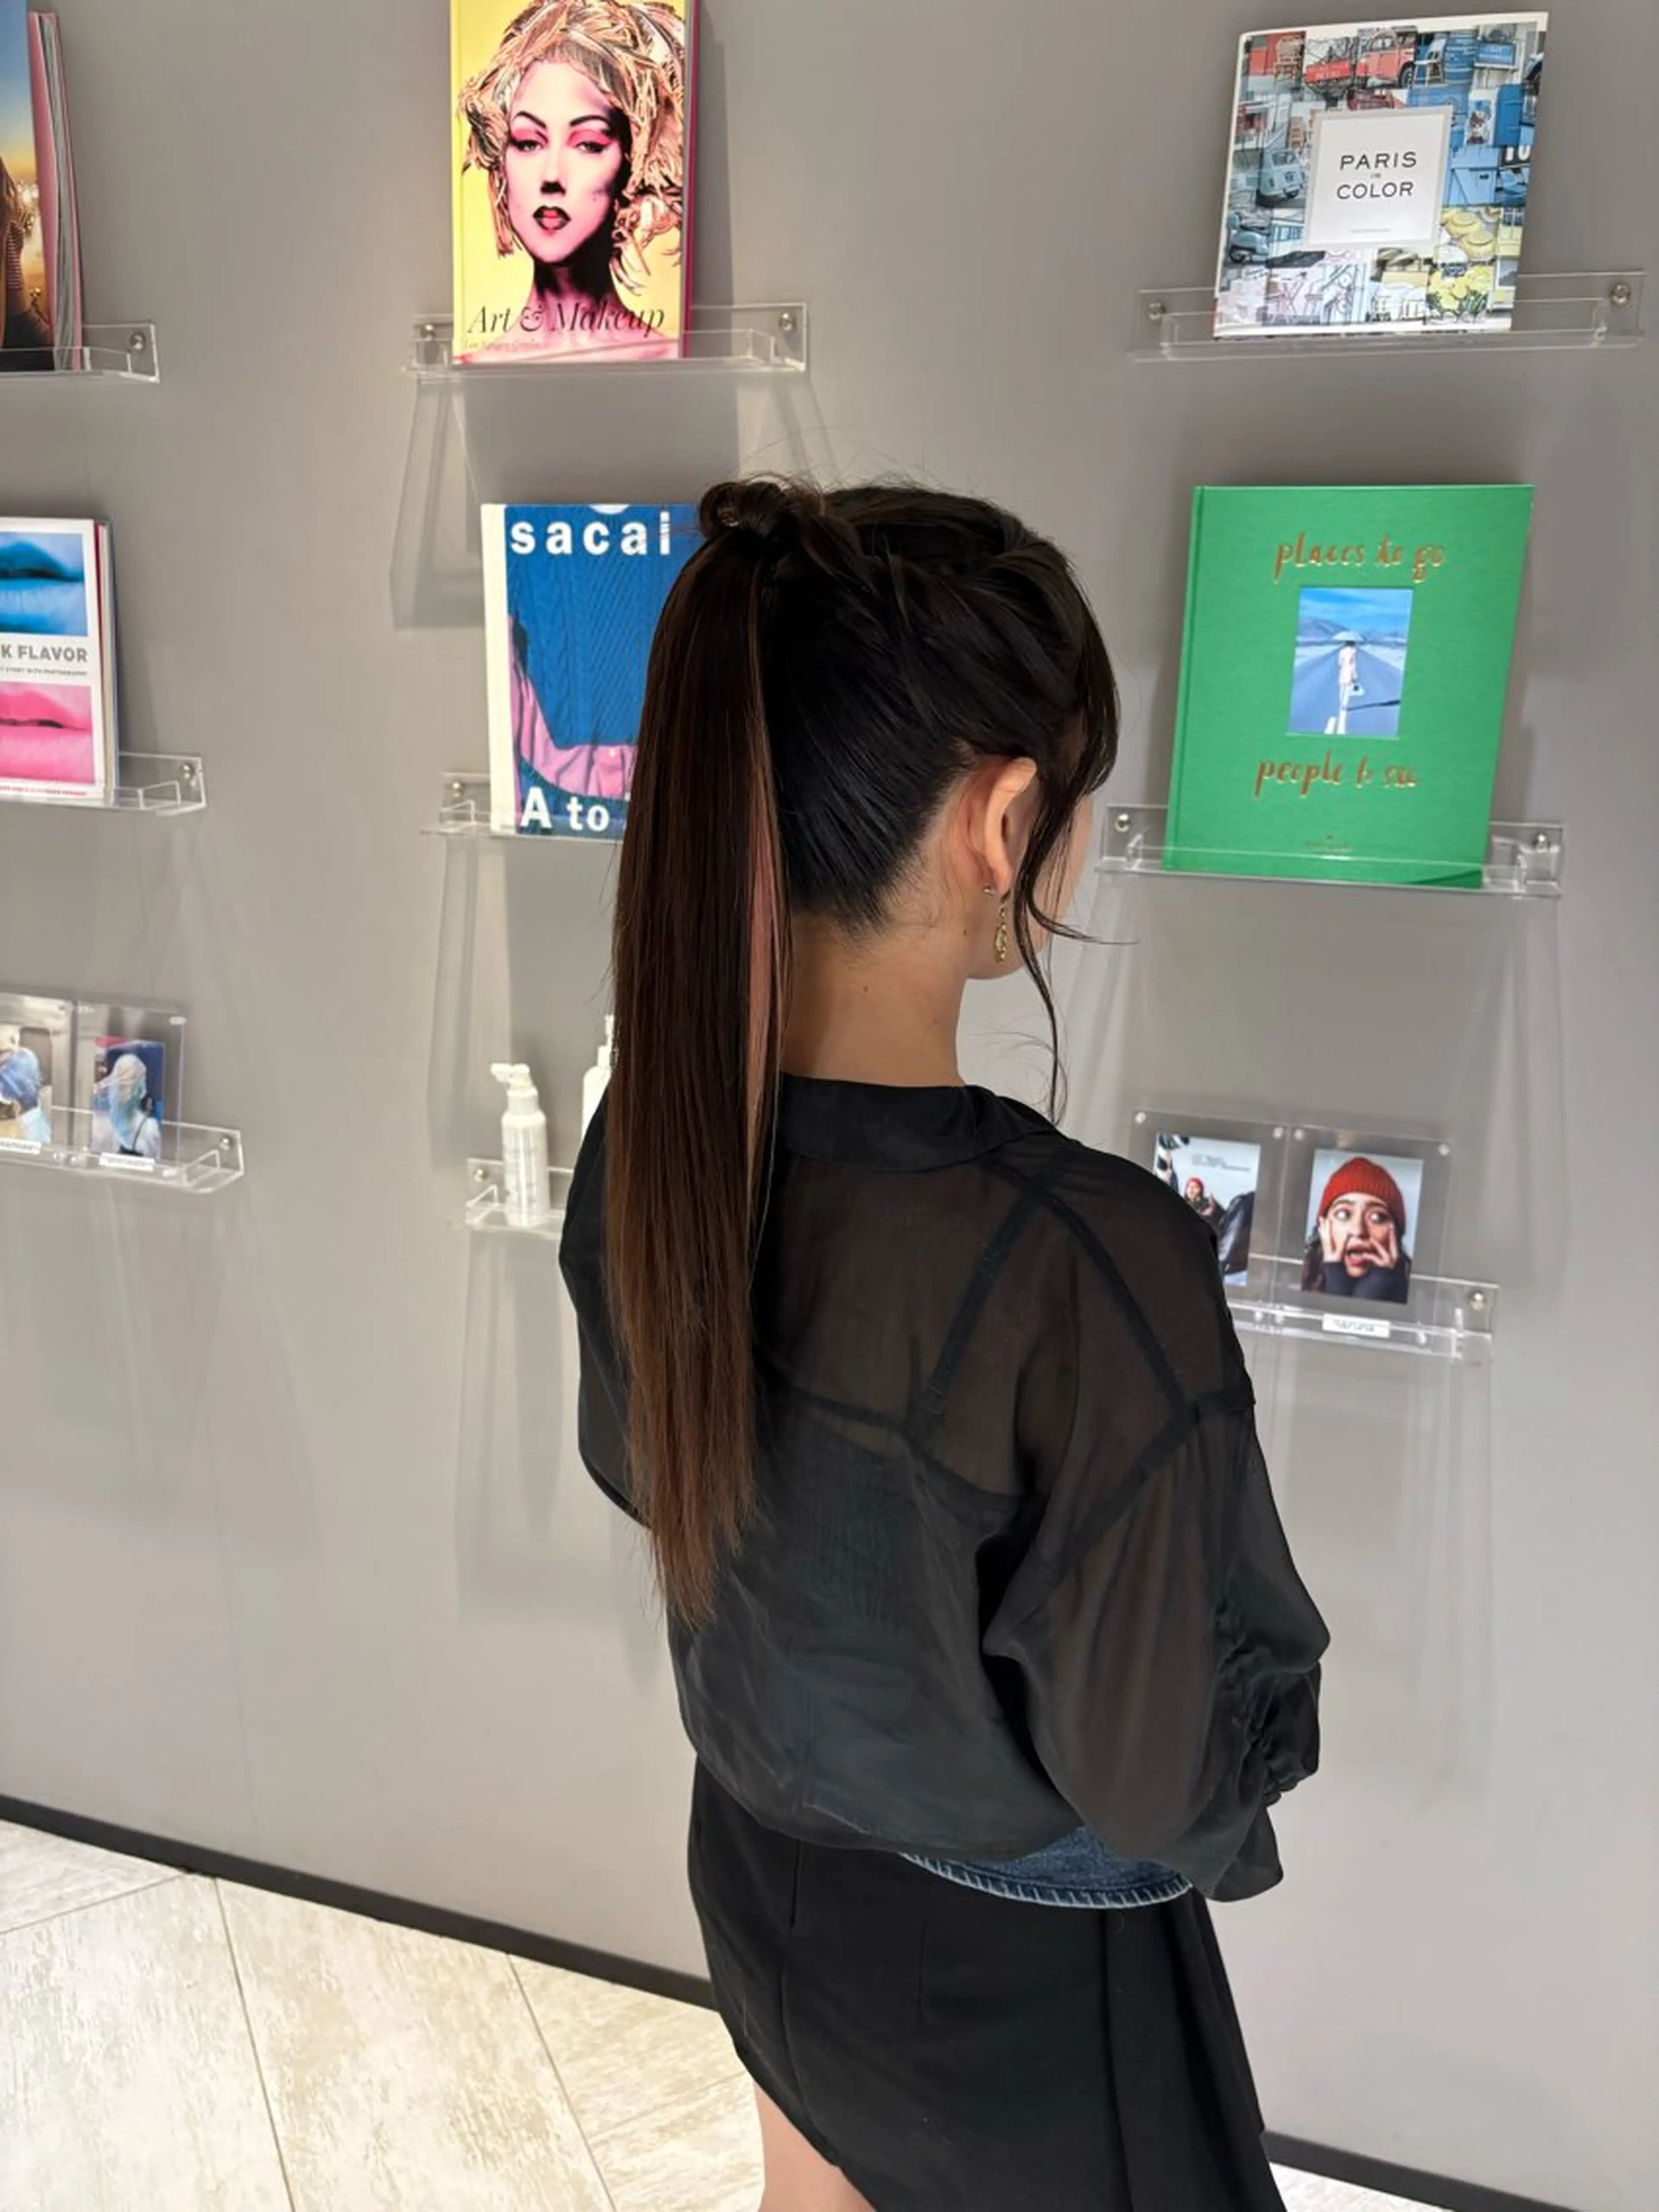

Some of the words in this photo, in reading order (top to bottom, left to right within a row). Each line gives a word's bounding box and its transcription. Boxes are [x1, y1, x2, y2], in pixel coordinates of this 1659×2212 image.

[1340, 151, 1417, 170] PARIS
[1337, 181, 1414, 200] COLOR
[467, 305, 511, 333] Art
[519, 304, 545, 332] &
[550, 301, 665, 338] Makeup
[510, 511, 671, 556] sacai
[1273, 531, 1365, 585] places
[1377, 531, 1403, 568] to
[1411, 544, 1445, 583] go
[1, 644, 12, 658] K
[18, 645, 89, 662] FLAVOR
[1254, 749, 1343, 800] people
[520, 787, 553, 829] A
[566, 796, 610, 832] to
